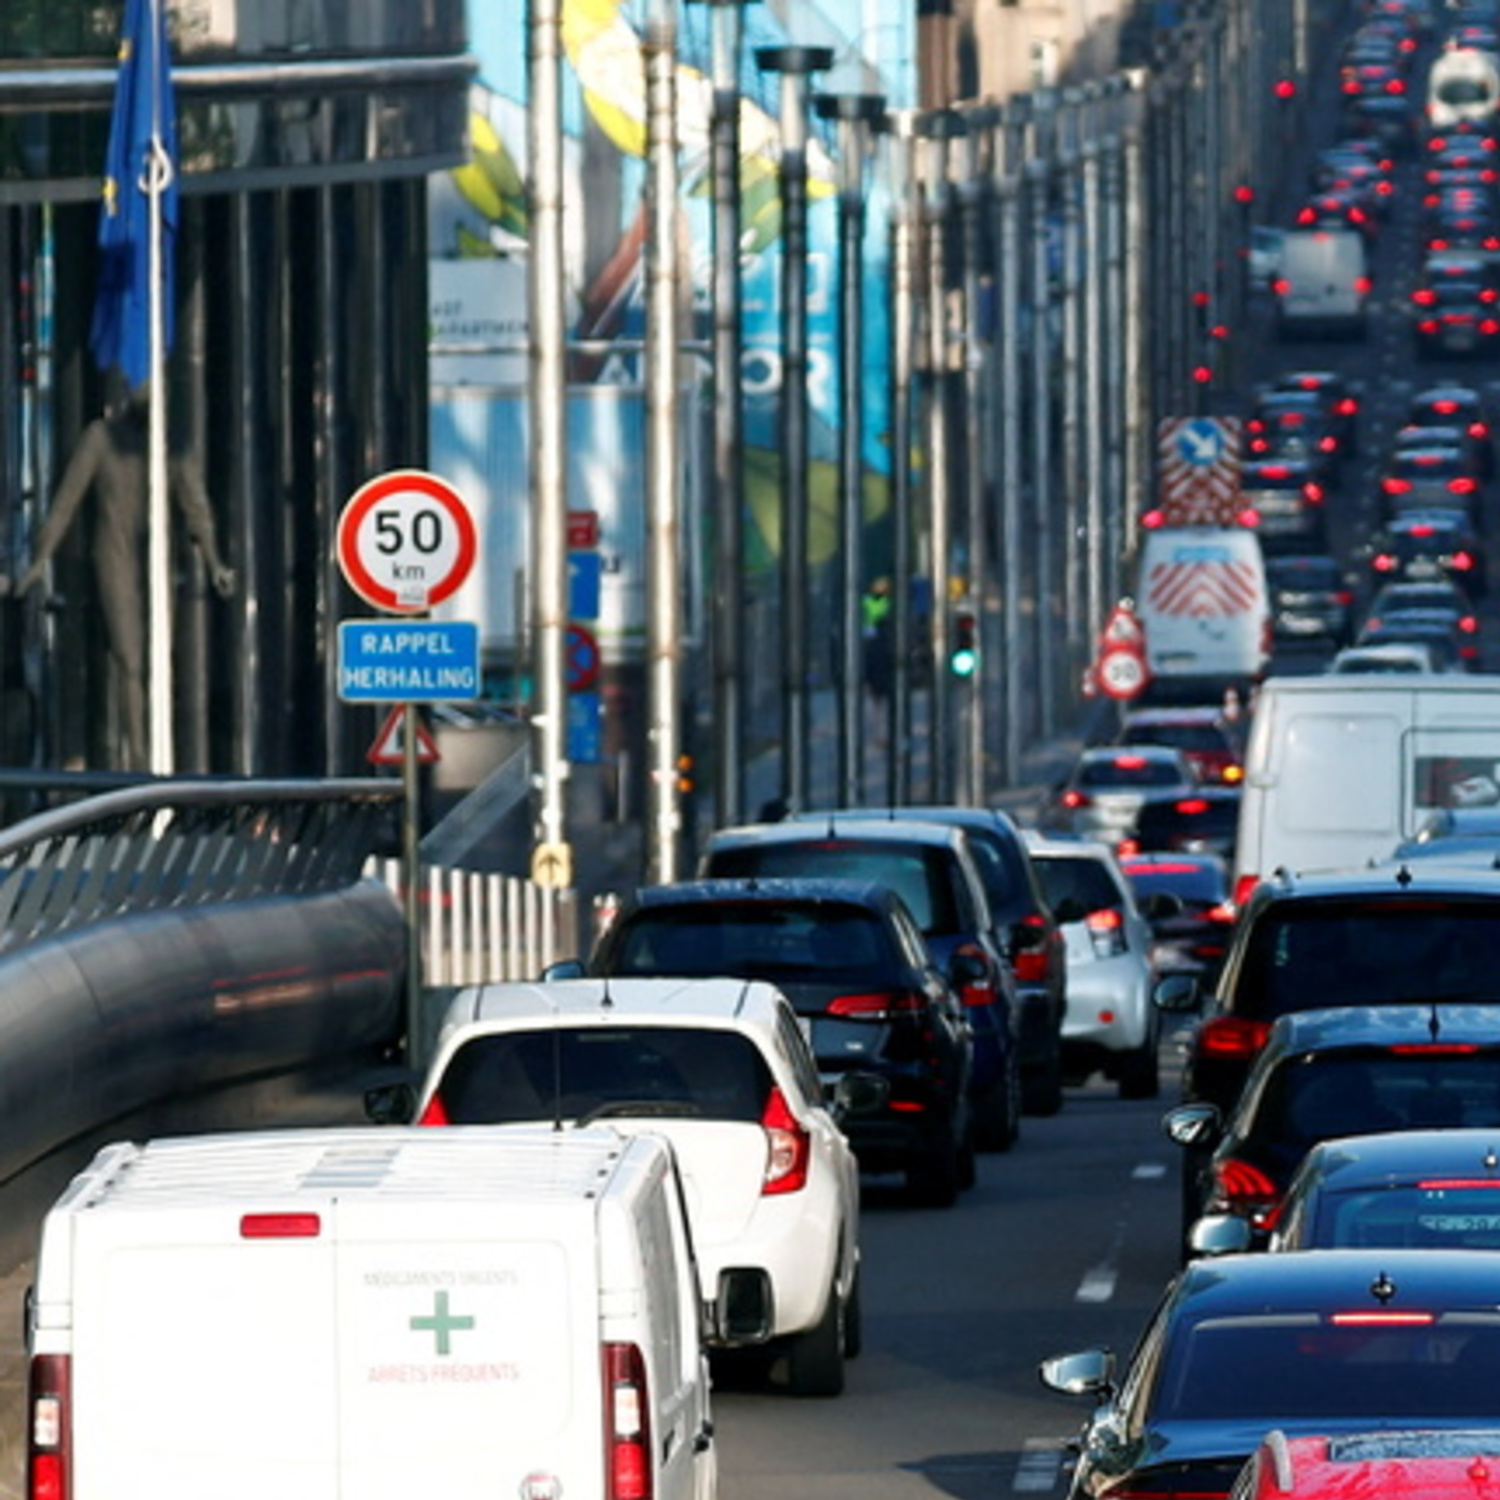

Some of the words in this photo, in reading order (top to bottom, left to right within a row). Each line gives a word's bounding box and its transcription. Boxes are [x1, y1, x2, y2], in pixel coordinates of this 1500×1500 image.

[374, 509, 443, 555] 50
[392, 561, 425, 580] km
[361, 633, 454, 654] RAPPEL
[344, 667, 474, 689] HERHALING
